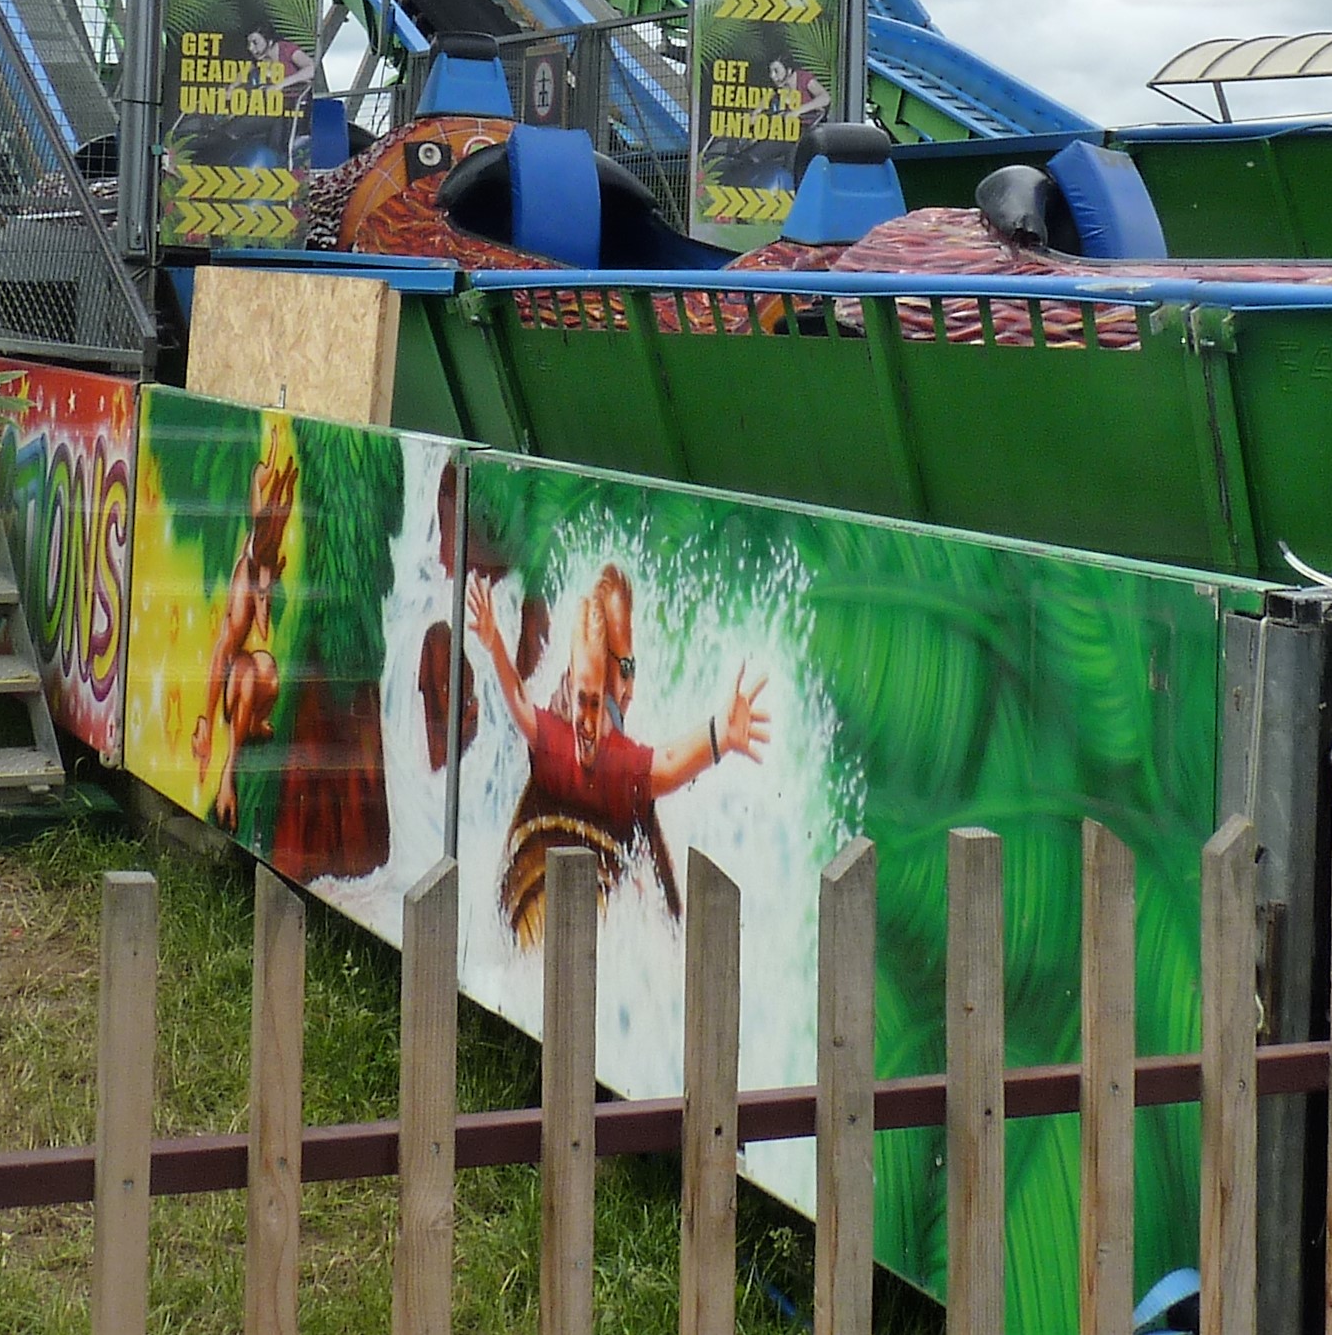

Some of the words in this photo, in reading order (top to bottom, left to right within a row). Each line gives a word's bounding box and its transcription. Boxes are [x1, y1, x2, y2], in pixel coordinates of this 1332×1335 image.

[181, 32, 223, 57] GET
[180, 58, 253, 84] READY
[257, 60, 285, 84] TO
[712, 59, 749, 83] GET
[179, 85, 304, 118] UNLOAD...
[711, 84, 775, 110] READY
[777, 88, 802, 111] TO
[710, 110, 801, 142] UNLOAD
